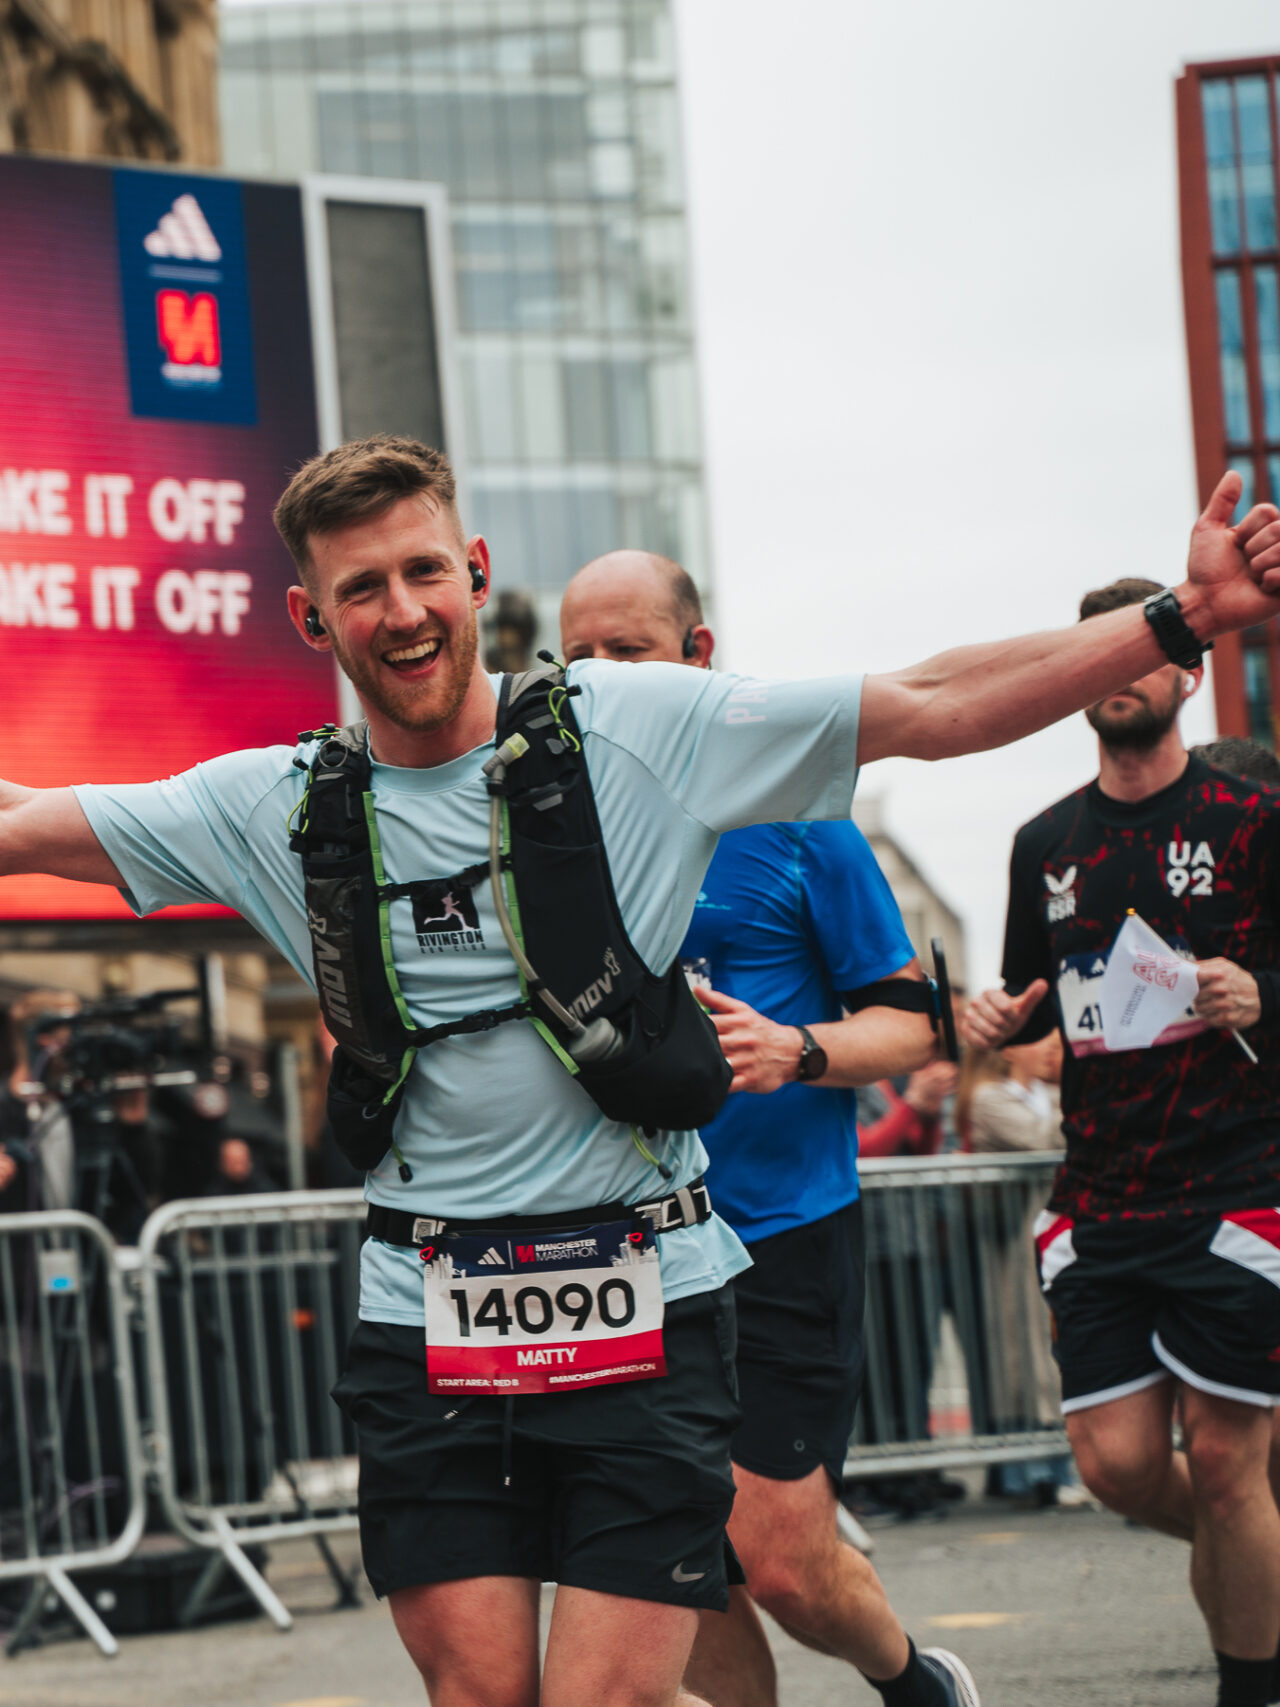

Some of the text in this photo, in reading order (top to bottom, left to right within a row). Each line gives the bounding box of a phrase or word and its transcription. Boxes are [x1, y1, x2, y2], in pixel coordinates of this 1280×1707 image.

[85, 473, 134, 538] IT
[149, 477, 245, 544] OFF
[91, 565, 140, 631] IT
[156, 570, 252, 636] OFF
[1168, 841, 1215, 868] UA
[1166, 867, 1213, 897] 92
[416, 930, 485, 947] RIVINGTON
[535, 1239, 597, 1252] MANCHESTER
[536, 1246, 599, 1261] MARATHON
[449, 1278, 636, 1337] 14090
[517, 1347, 577, 1367] MATTY
[436, 1378, 464, 1387] START
[549, 1362, 657, 1384] #MANCHESTERMARATHON
